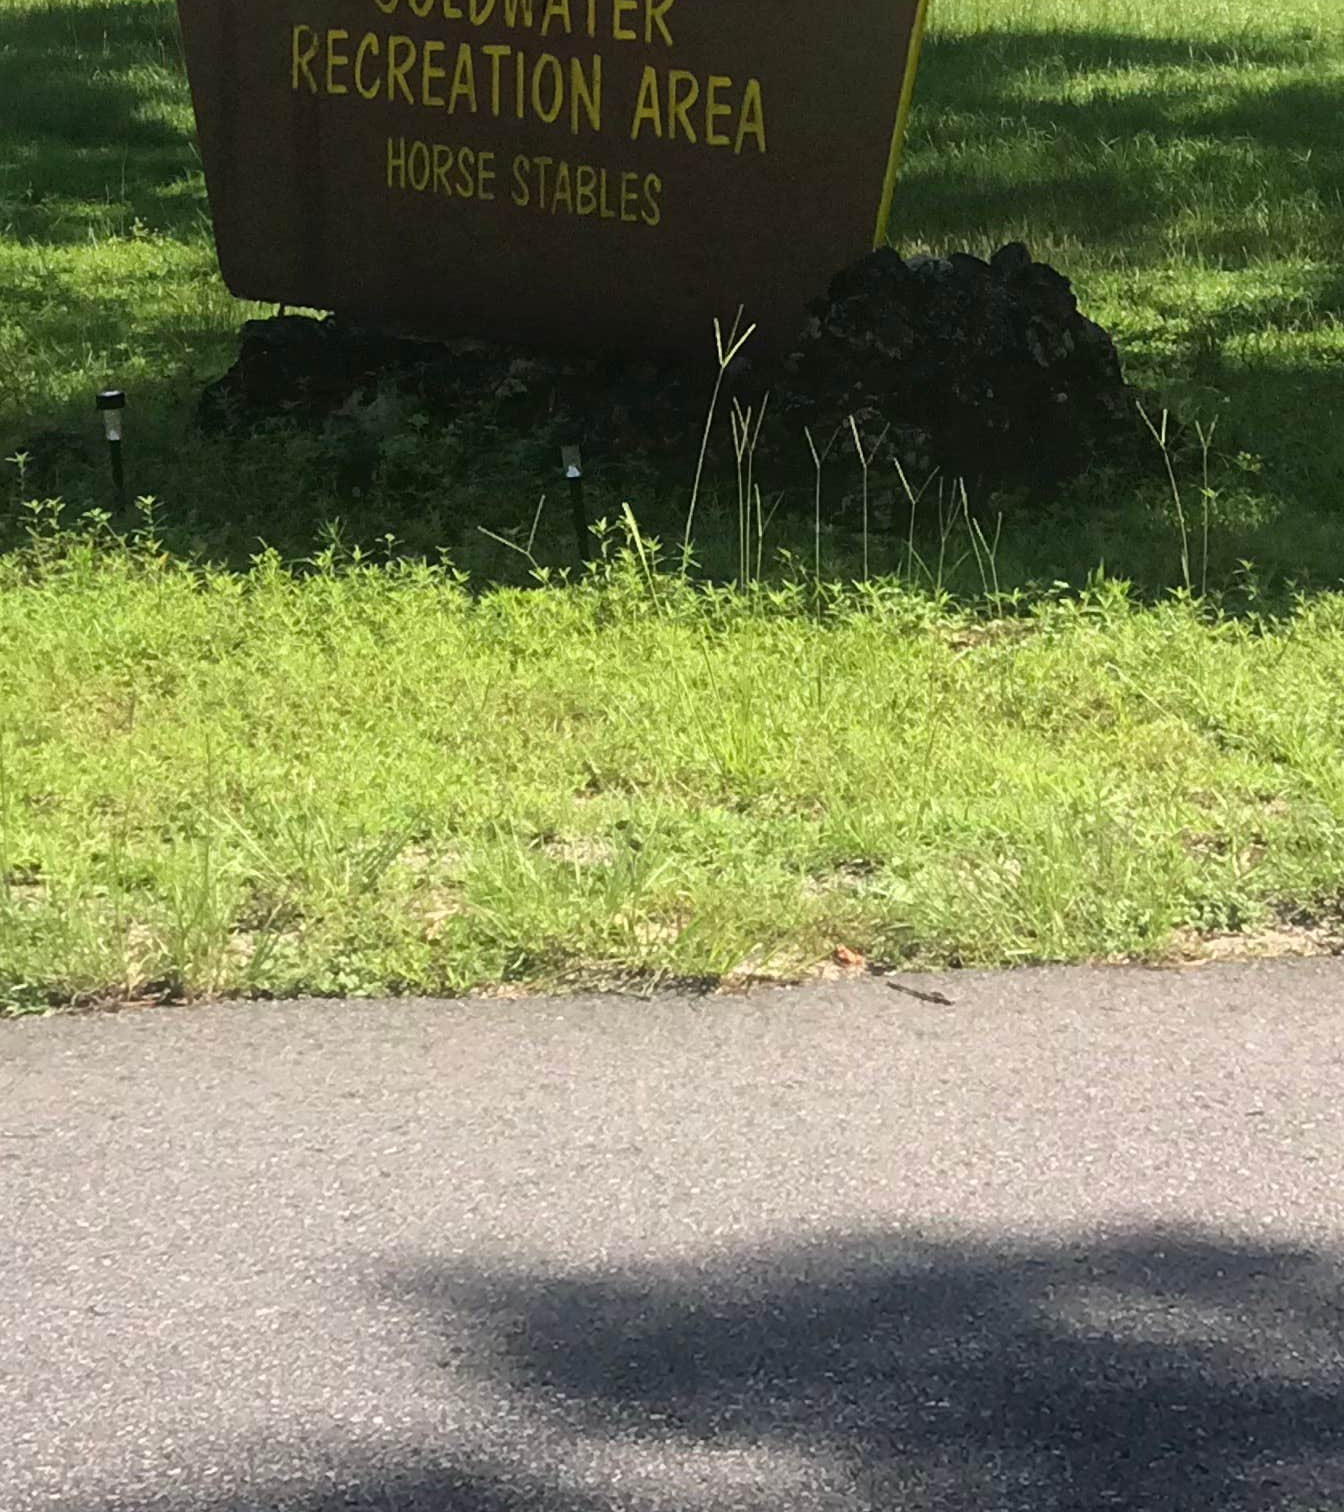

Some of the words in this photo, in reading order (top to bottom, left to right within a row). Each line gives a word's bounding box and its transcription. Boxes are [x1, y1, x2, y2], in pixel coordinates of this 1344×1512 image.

[292, 24, 602, 135] RECREATION
[632, 67, 767, 155] AREA
[387, 138, 495, 200] HORSE
[512, 158, 662, 226] STABLES
